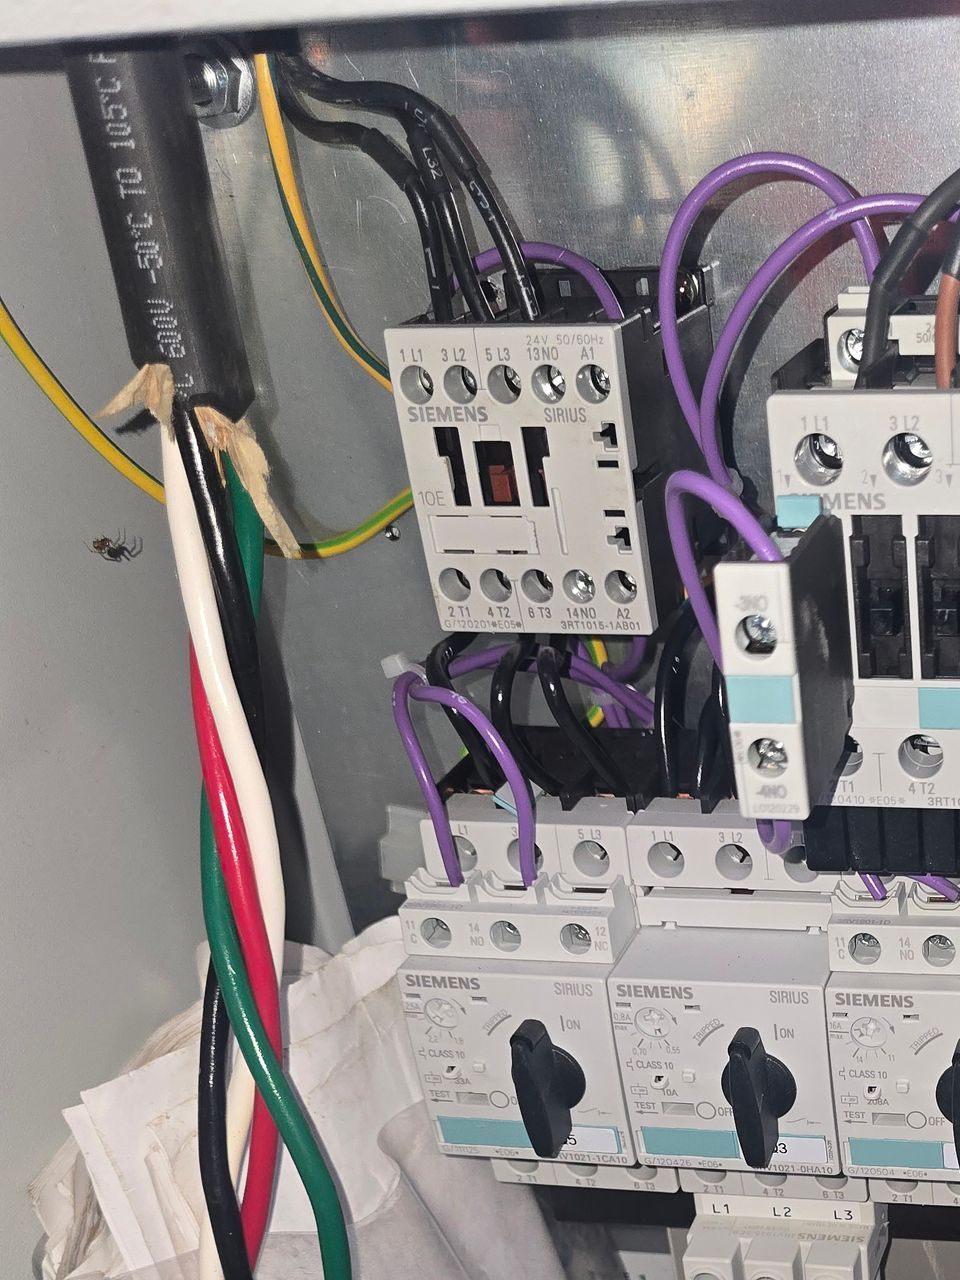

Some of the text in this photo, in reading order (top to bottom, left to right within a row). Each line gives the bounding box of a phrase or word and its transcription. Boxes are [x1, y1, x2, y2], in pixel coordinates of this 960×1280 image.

[116, 167, 146, 200] TO
[147, 298, 186, 360] 600V
[526, 333, 604, 346] 24V 50/60Hz
[400, 348, 423, 362] 1 L1
[442, 348, 466, 362] 3 L2
[486, 348, 511, 362] 5 L3
[581, 347, 596, 360] A1
[407, 406, 488, 423] SIEMENS
[544, 407, 587, 423] SIRIUS
[801, 416, 829, 431] 1 L1
[889, 415, 920, 431] 3 L2
[418, 490, 445, 506] 10E
[448, 606, 471, 618] 2 T1
[487, 606, 511, 618] 4 T2
[528, 607, 552, 619] 6 T3
[617, 608, 631, 619] A2
[561, 620, 640, 631] 3RT1015-1AB01
[840, 780, 854, 792] T1
[908, 782, 935, 795] 4 T2
[458, 824, 468, 835] L1
[578, 829, 602, 840] 5 L3
[652, 830, 674, 841] 1 L1
[719, 832, 743, 843] 3 L2
[405, 920, 415, 930] 11
[468, 922, 479, 933] 14
[595, 926, 606, 936] 12
[411, 935, 418, 944] C
[470, 936, 484, 946] NO
[835, 937, 845, 948] 11
[899, 937, 911, 948] 14
[594, 940, 608, 951] NC
[838, 949, 846, 960] C
[899, 949, 914, 961] NO
[405, 974, 481, 990] SIEMENS
[553, 982, 593, 997] SIRIUS
[616, 984, 694, 999] SIEMENS
[769, 990, 809, 1005] SIRIUS
[834, 992, 914, 1008] SIEMENS
[566, 1019, 581, 1030] ON
[692, 1018, 721, 1042] TRIPPED
[829, 1021, 842, 1030] 16A
[780, 1029, 795, 1039] ON
[909, 1026, 940, 1050] TRIPPED
[429, 1049, 466, 1060] CLASS 10
[636, 1060, 674, 1071] CLASS 10
[848, 1069, 888, 1080] CLASS 10
[429, 1090, 450, 1099] TEST
[634, 1101, 656, 1110] TEST
[843, 1110, 866, 1120] TEST
[928, 1116, 946, 1126] OFF
[557, 1152, 628, 1164] RV1021-1CA10
[644, 1157, 833, 1175] G/120426 V1021-0HA10
[847, 1167, 895, 1177] G/120504
[714, 1185, 724, 1193] T1
[773, 1188, 784, 1197] T2
[903, 1194, 913, 1203] T1
[712, 1203, 730, 1214] L1
[773, 1206, 792, 1217] L2
[834, 1209, 853, 1220] L3
[797, 1232, 865, 1242] SIEMENS
